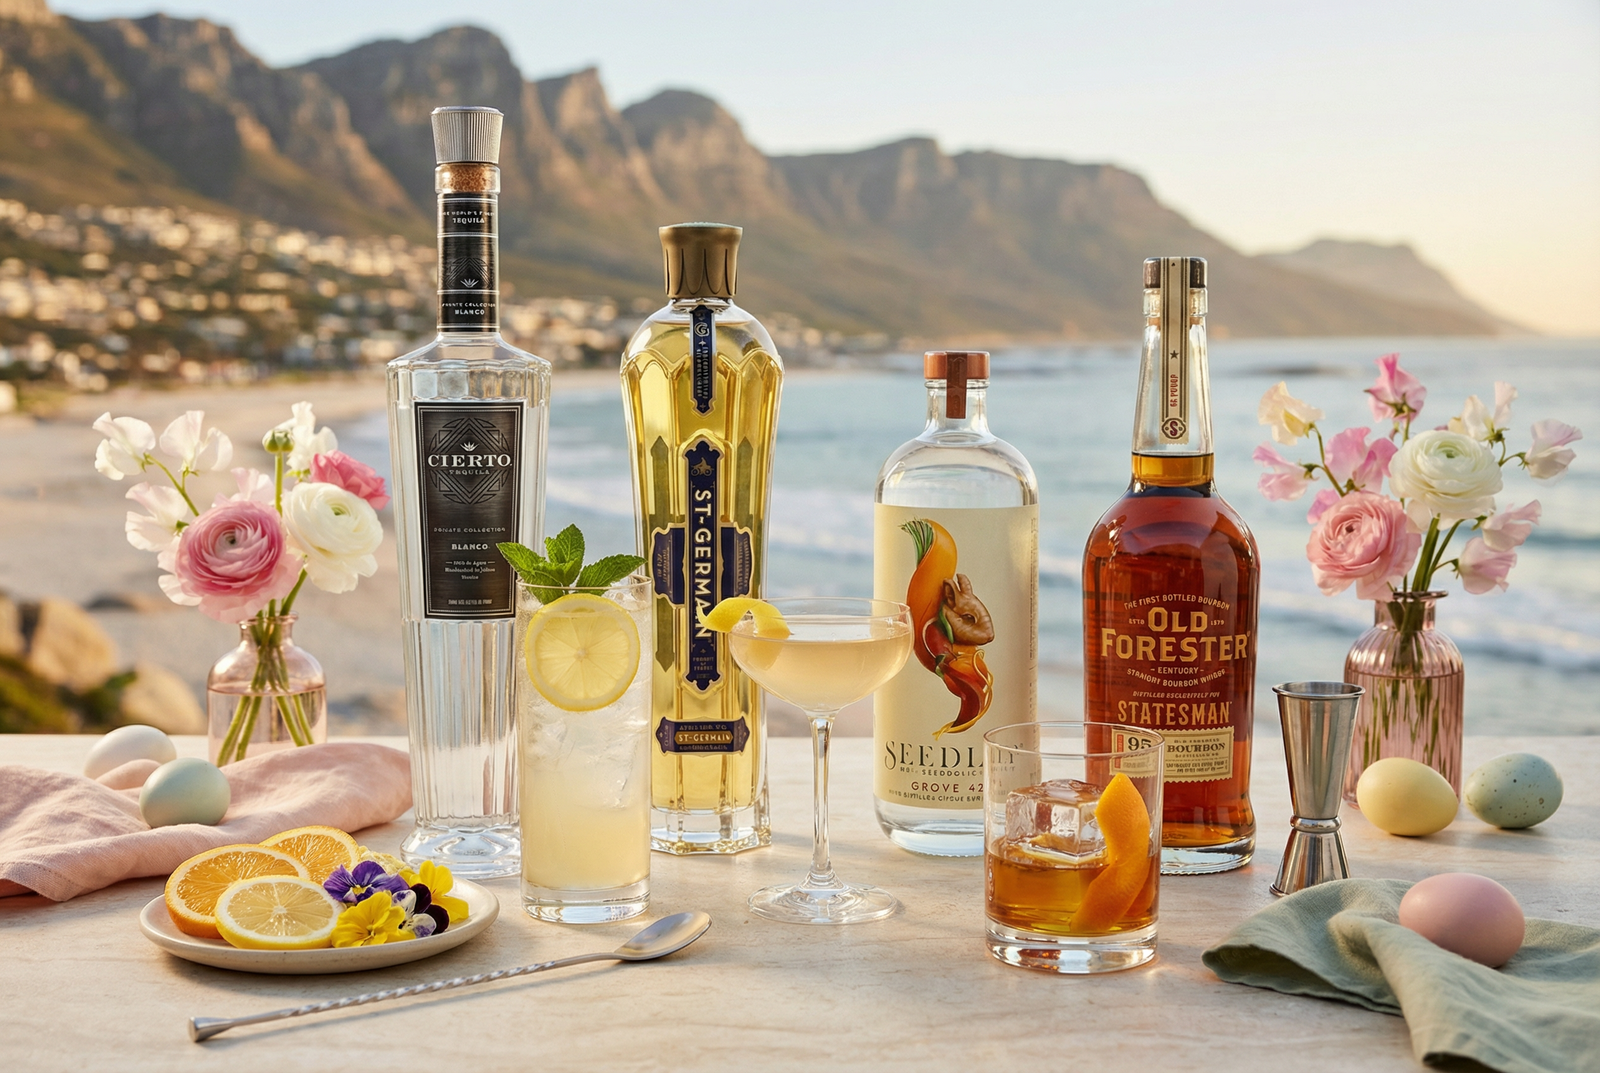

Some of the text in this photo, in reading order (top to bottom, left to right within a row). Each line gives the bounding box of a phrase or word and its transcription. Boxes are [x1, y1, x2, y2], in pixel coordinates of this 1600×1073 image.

[427, 453, 512, 468] CIERTO
[694, 489, 712, 638] ST-GERMAN
[1138, 595, 1160, 606] FIRST
[1162, 593, 1196, 602] BOTTLED
[1148, 606, 1208, 633] OLD
[1101, 627, 1248, 663] FORESTER
[1162, 678, 1199, 688] BOURBON
[1117, 700, 1230, 726] STATESMAN
[1166, 742, 1226, 753] BOURBON
[910, 780, 960, 793] GROVE
[968, 783, 984, 793] 42
